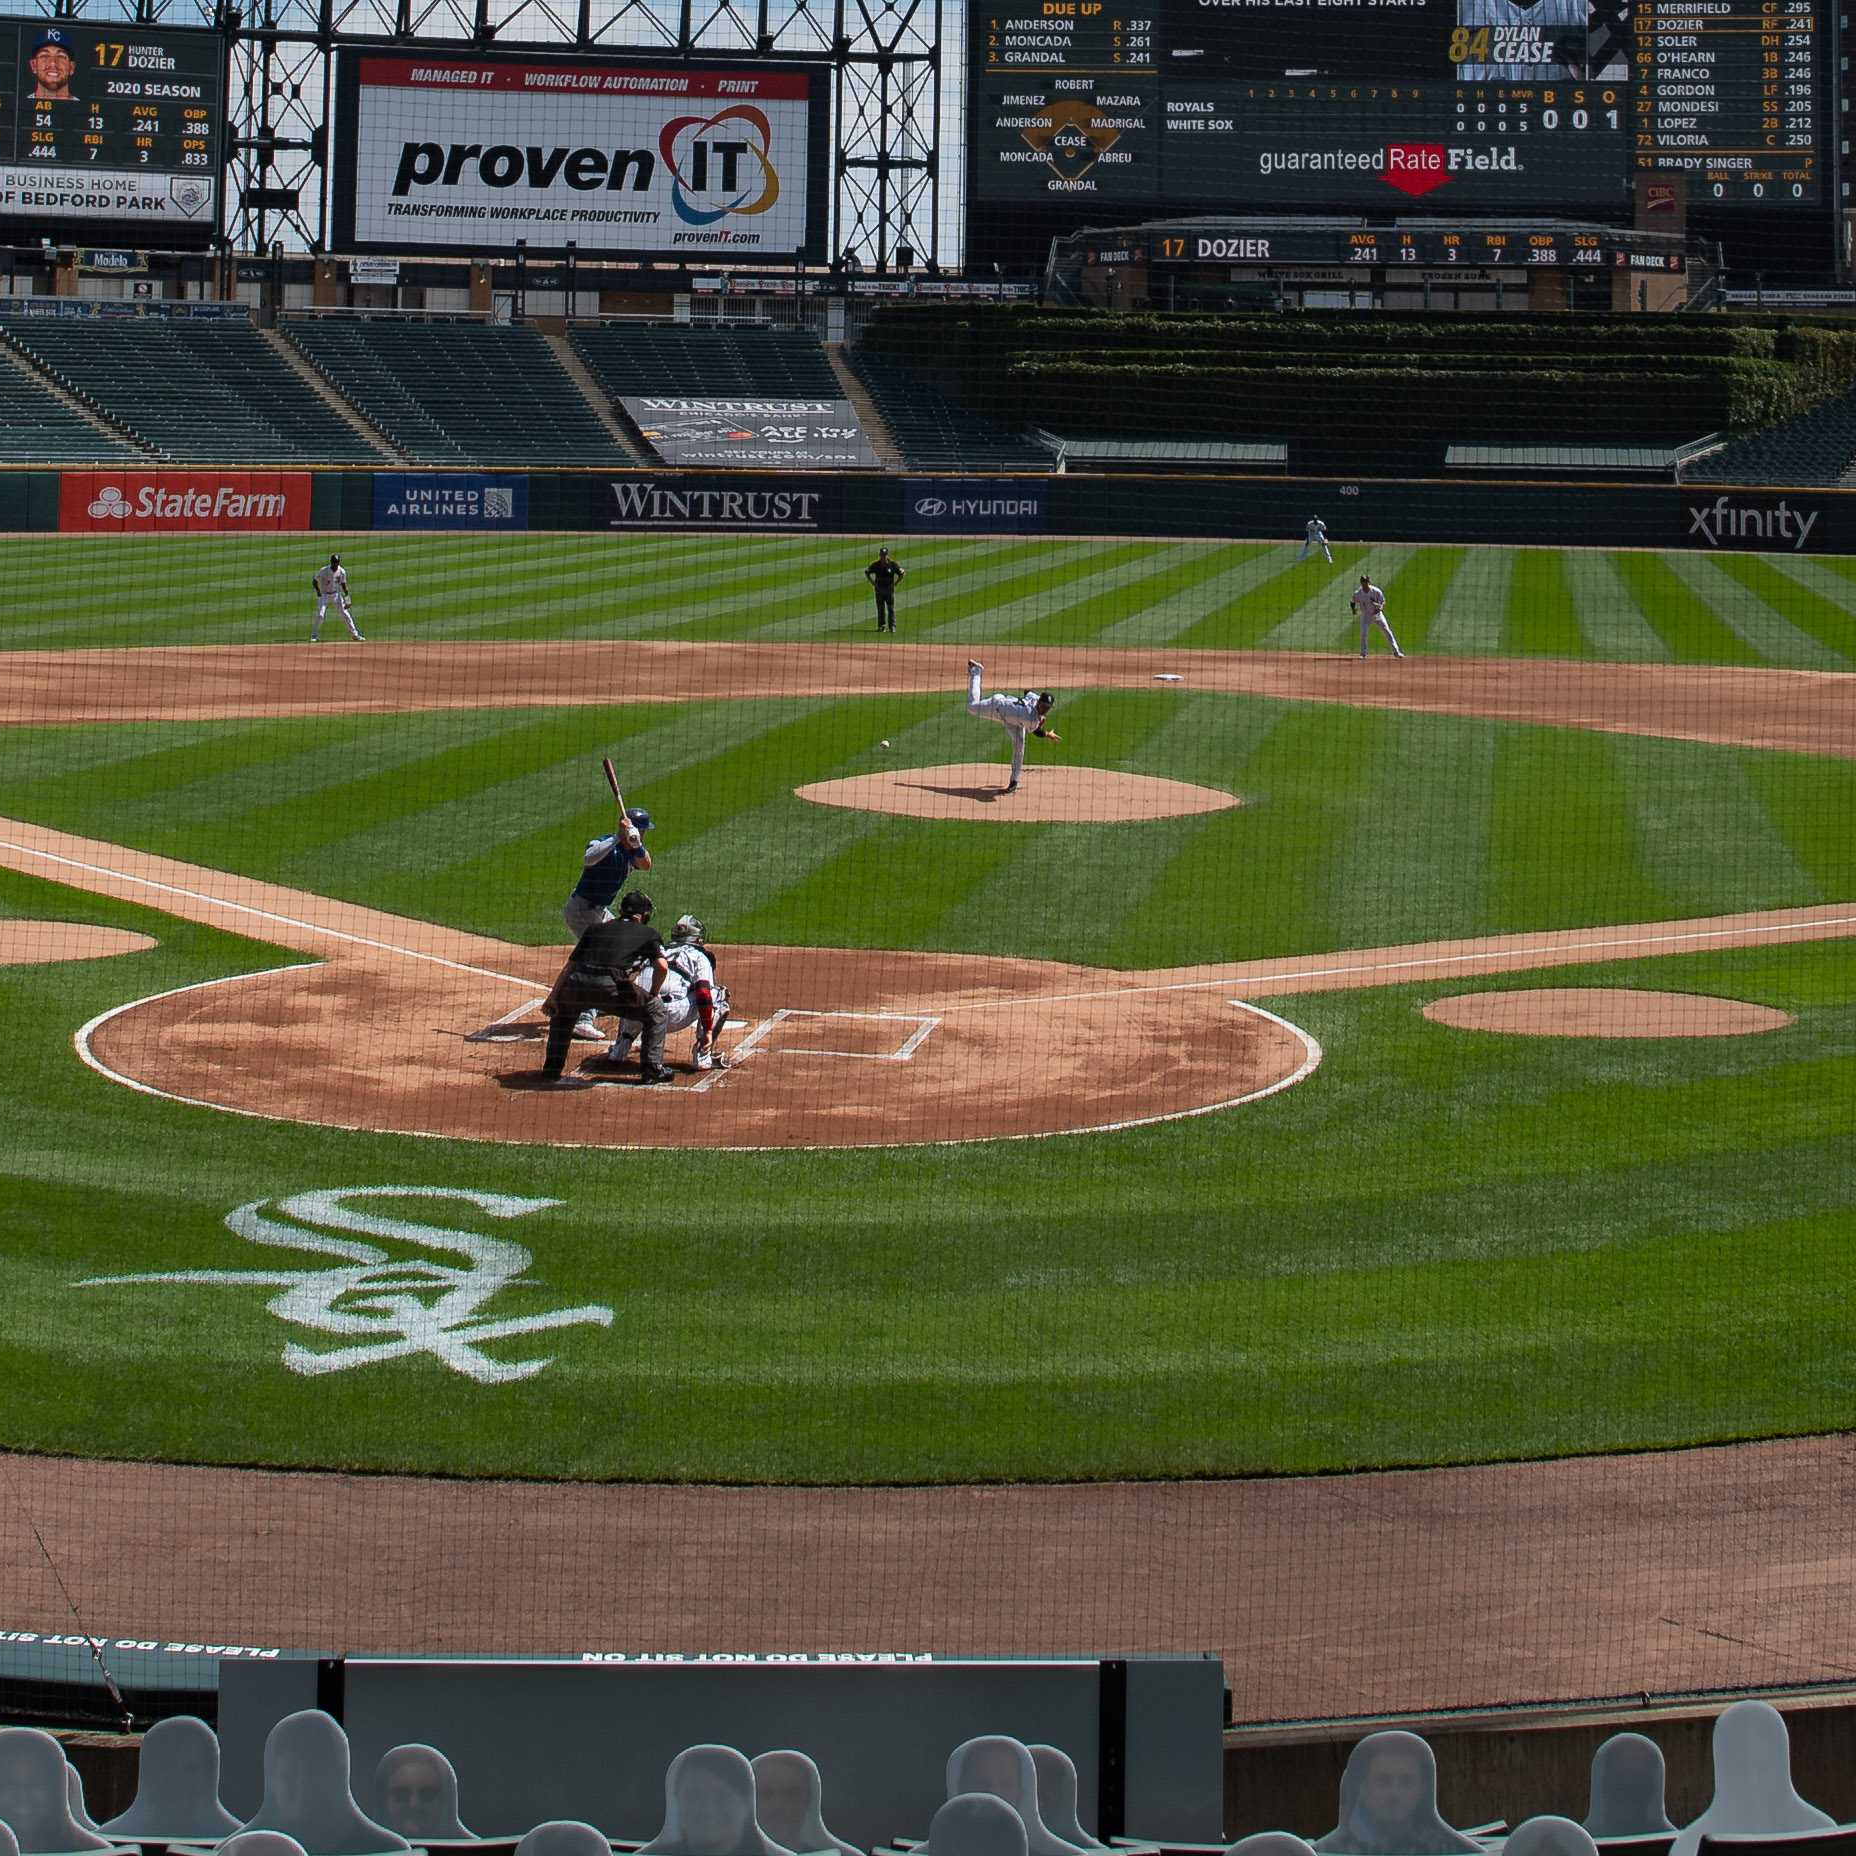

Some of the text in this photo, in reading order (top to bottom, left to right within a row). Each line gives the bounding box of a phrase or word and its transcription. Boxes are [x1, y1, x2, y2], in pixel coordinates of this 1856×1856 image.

[1043, 3, 1101, 15] DUE UP
[1657, 2, 1730, 13] MERRIFIELD
[1005, 20, 1074, 31] ANDERSON
[1657, 20, 1704, 30] DOZIER
[1494, 28, 1540, 42] DYLAN
[1005, 36, 1071, 47] MONCADA
[1449, 28, 1490, 63] 84
[1657, 36, 1697, 46] SOLER
[95, 43, 124, 66] 17
[128, 45, 164, 55] HUNTER
[1493, 42, 1553, 63] CEASE
[1005, 52, 1065, 63] GRANDAL
[1657, 52, 1715, 62] O'HEARN
[128, 56, 175, 70] DOZIER
[1657, 68, 1710, 78] FRANCO
[411, 69, 758, 93] MANAGED IT WORKFLOW AUTOMATION PRINT
[1055, 80, 1094, 90] ROBERT
[107, 81, 200, 97] 2020 SEASON
[1657, 85, 1714, 96] GORDON
[1002, 95, 1045, 105] JIMENEZ
[1097, 96, 1140, 106] MAZARA
[1658, 102, 1719, 112] MONDESI
[1091, 118, 1145, 128] MADRIGAL
[1657, 118, 1696, 128] LOPEZ
[1657, 135, 1708, 145] VILORIA
[1098, 153, 1131, 163] ABREU
[1260, 149, 1383, 174] guaranteed
[1390, 149, 1440, 170] Rate
[392, 141, 747, 196] proven IT
[6, 175, 85, 188] BUSINESS
[91, 179, 137, 191] HOME
[22, 192, 110, 208] BEDFORD
[116, 196, 166, 211] PARK
[387, 204, 660, 223] TRANSFORMING WORKPLACE PRODUCTIVITY
[673, 231, 760, 245] provenIT.com
[1163, 239, 1269, 258] 17 DOZIER
[406, 490, 479, 502] UNITED
[1339, 485, 1359, 496] 400
[611, 483, 819, 520] WINTRUST
[387, 504, 479, 515] AIRLINES
[953, 500, 1037, 515] HYUNDAI
[1688, 497, 1818, 546] xfinity
[43, 1634, 110, 1647] NOT
[115, 1640, 158, 1650] DO
[164, 1642, 280, 1657] PLEASE
